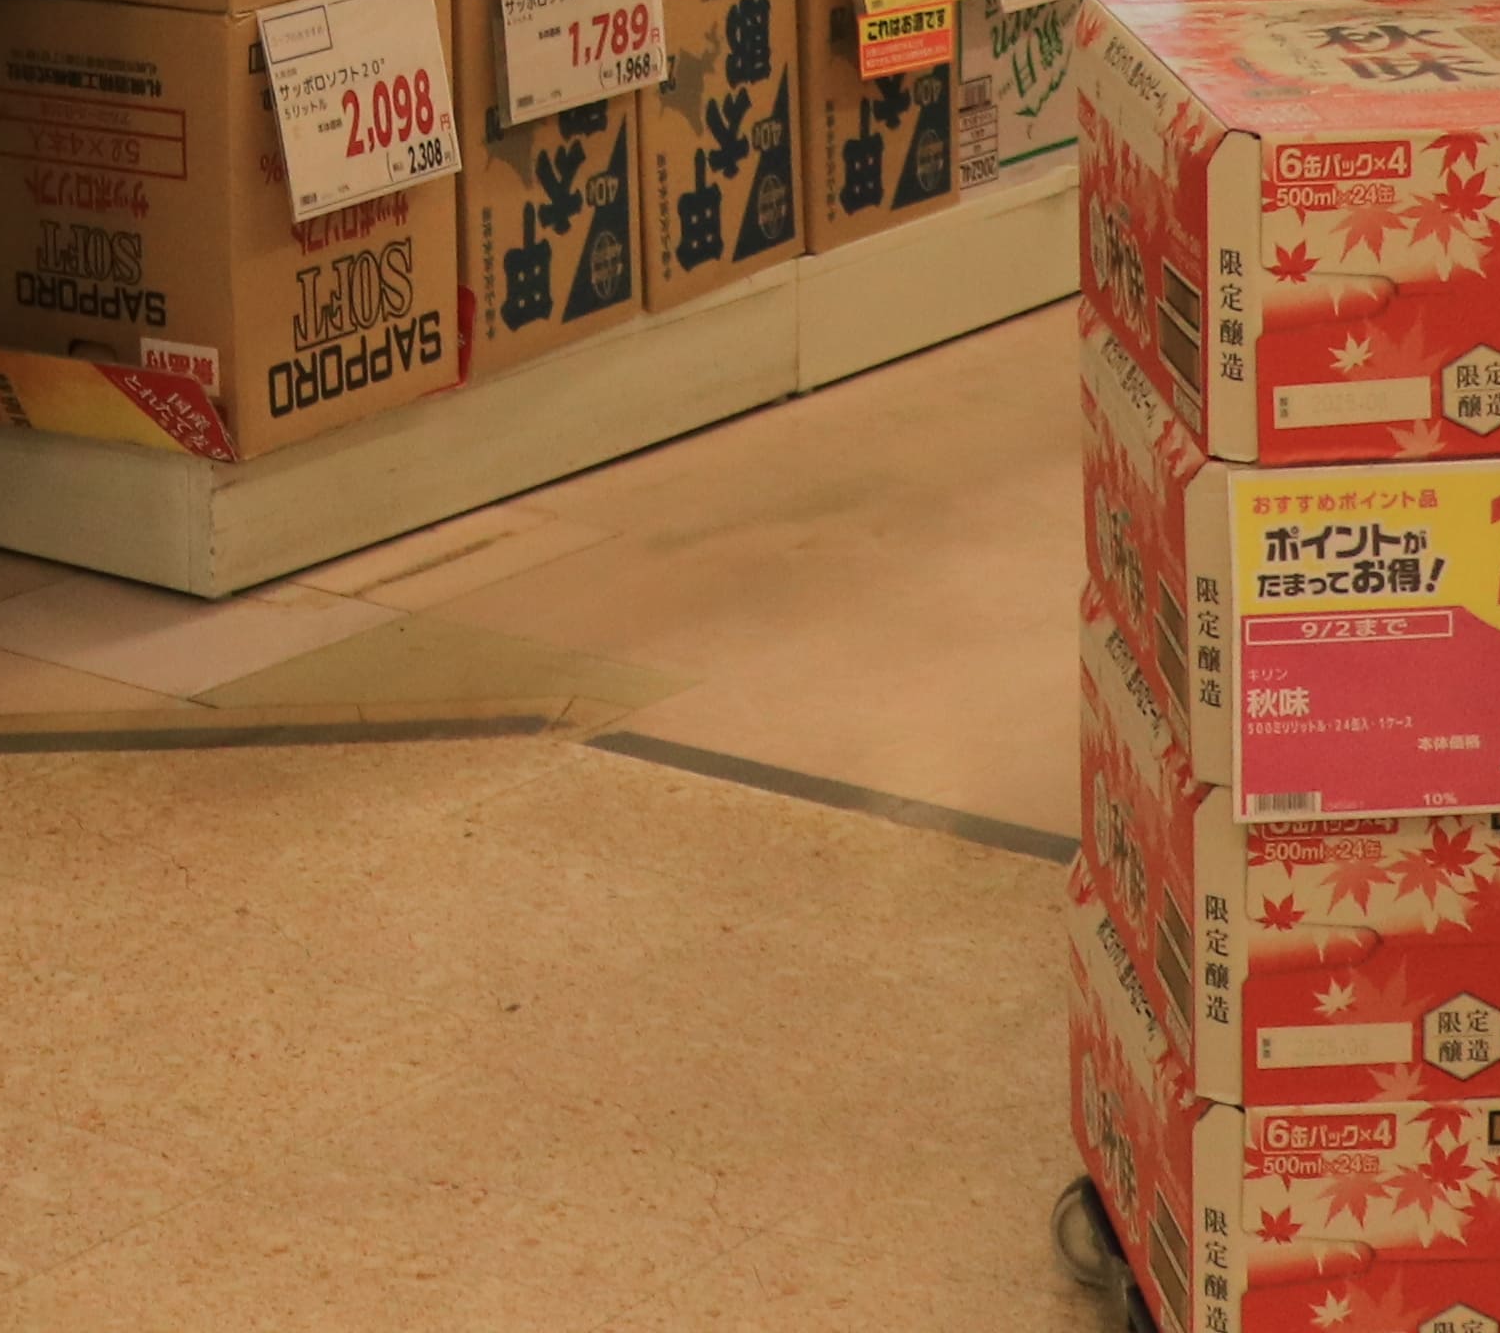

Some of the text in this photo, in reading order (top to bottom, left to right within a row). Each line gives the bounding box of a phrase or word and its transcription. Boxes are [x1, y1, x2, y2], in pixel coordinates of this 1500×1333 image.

[568, 4, 649, 67] 1,789
[867, 9, 945, 41] これはお酒です
[616, 55, 651, 85] 1,968
[344, 69, 433, 158] 2,098
[408, 140, 441, 175] 2,308
[36, 222, 142, 284] SOFT
[17, 273, 166, 326] SAPPORO
[294, 239, 413, 350] SOFT
[1218, 247, 1246, 382] 限定醸造
[269, 312, 441, 417] SAPPORO
[1251, 488, 1438, 517] おすすめポイント品
[1264, 525, 1427, 564] ポイントが
[1300, 616, 1408, 641] 9/2まで
[1247, 667, 1288, 683] キリン
[1246, 687, 1312, 720] 秋味
[1417, 732, 1482, 752] 本体価格
